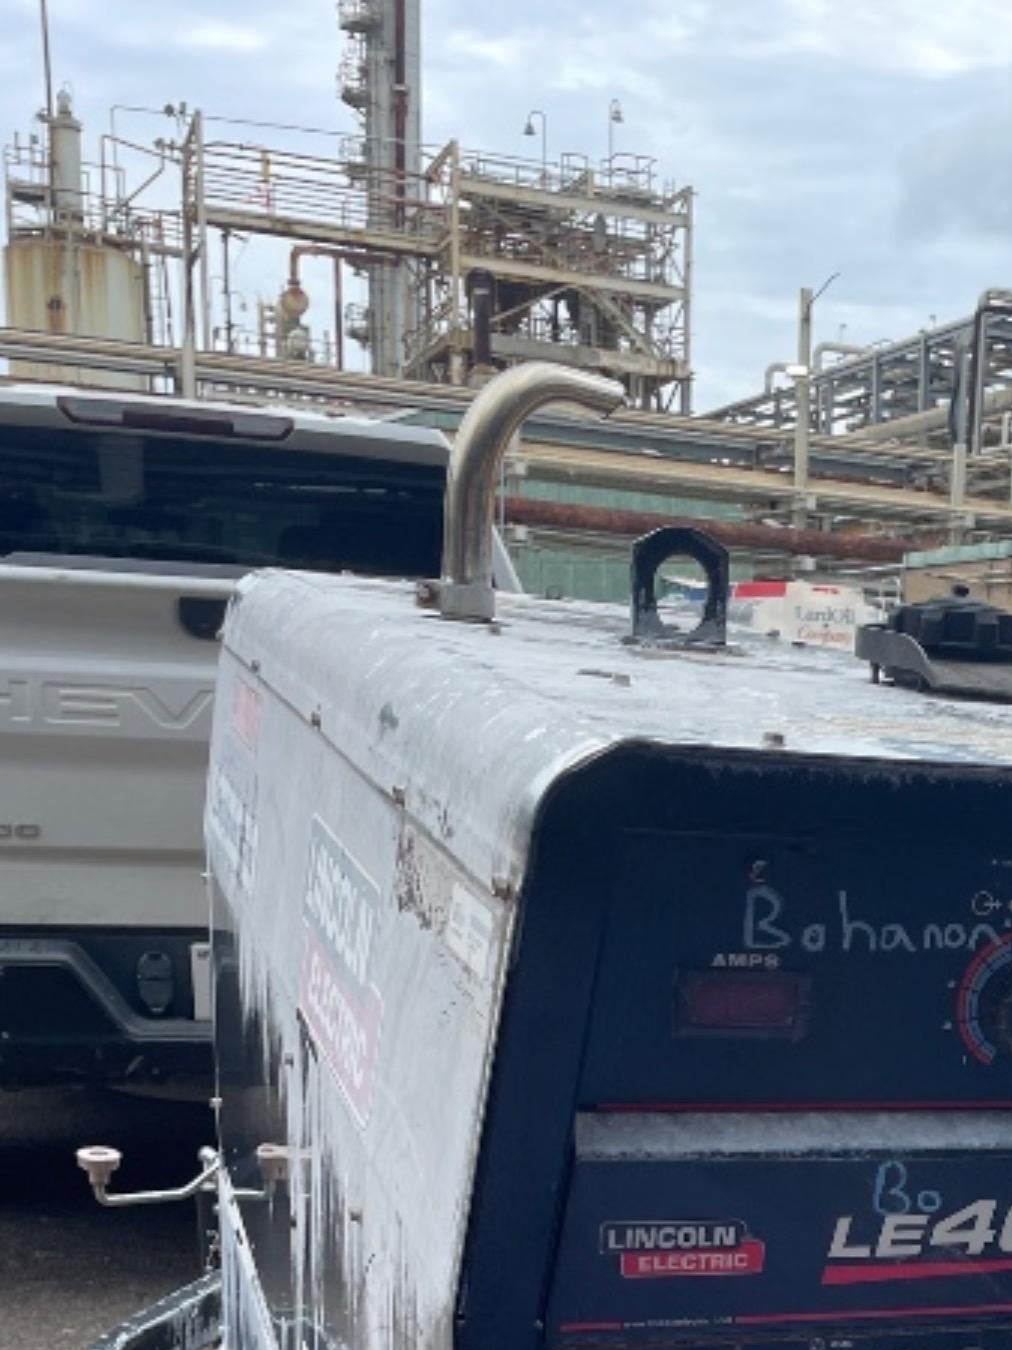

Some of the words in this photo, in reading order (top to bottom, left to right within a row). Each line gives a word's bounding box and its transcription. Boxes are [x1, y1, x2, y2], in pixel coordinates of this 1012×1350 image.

[711, 952, 780, 969] AMPS
[607, 1225, 738, 1250] LINCOLN
[637, 1251, 749, 1272] ELECTRIC
